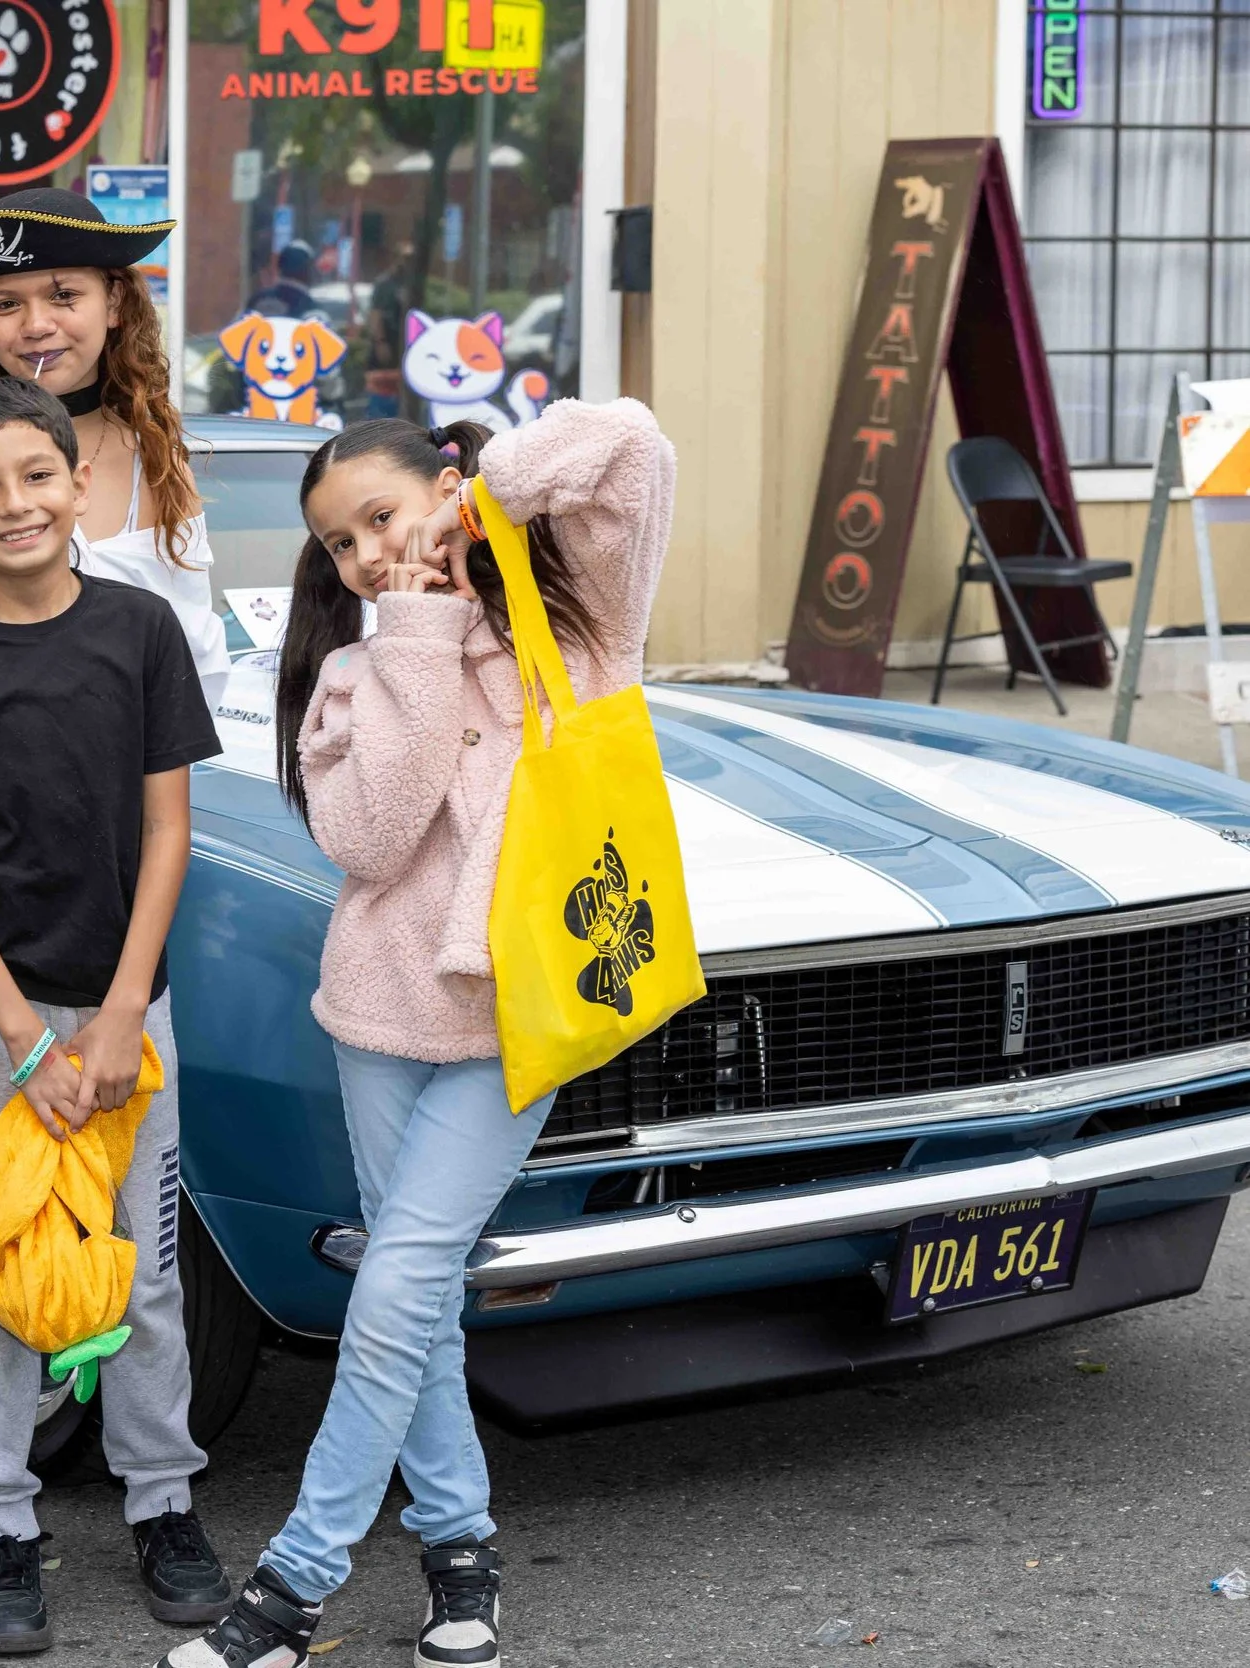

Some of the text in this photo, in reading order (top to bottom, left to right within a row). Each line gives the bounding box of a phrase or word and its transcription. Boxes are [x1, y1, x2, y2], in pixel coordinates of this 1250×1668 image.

[221, 67, 539, 99] ANIMAL RESCUE
[1043, 0, 1078, 109] PEN
[822, 241, 933, 609] TATTOO
[576, 852, 626, 931] HOS
[957, 1197, 1041, 1222] CALIFORNIA
[910, 1218, 1065, 1299] VDA 561
